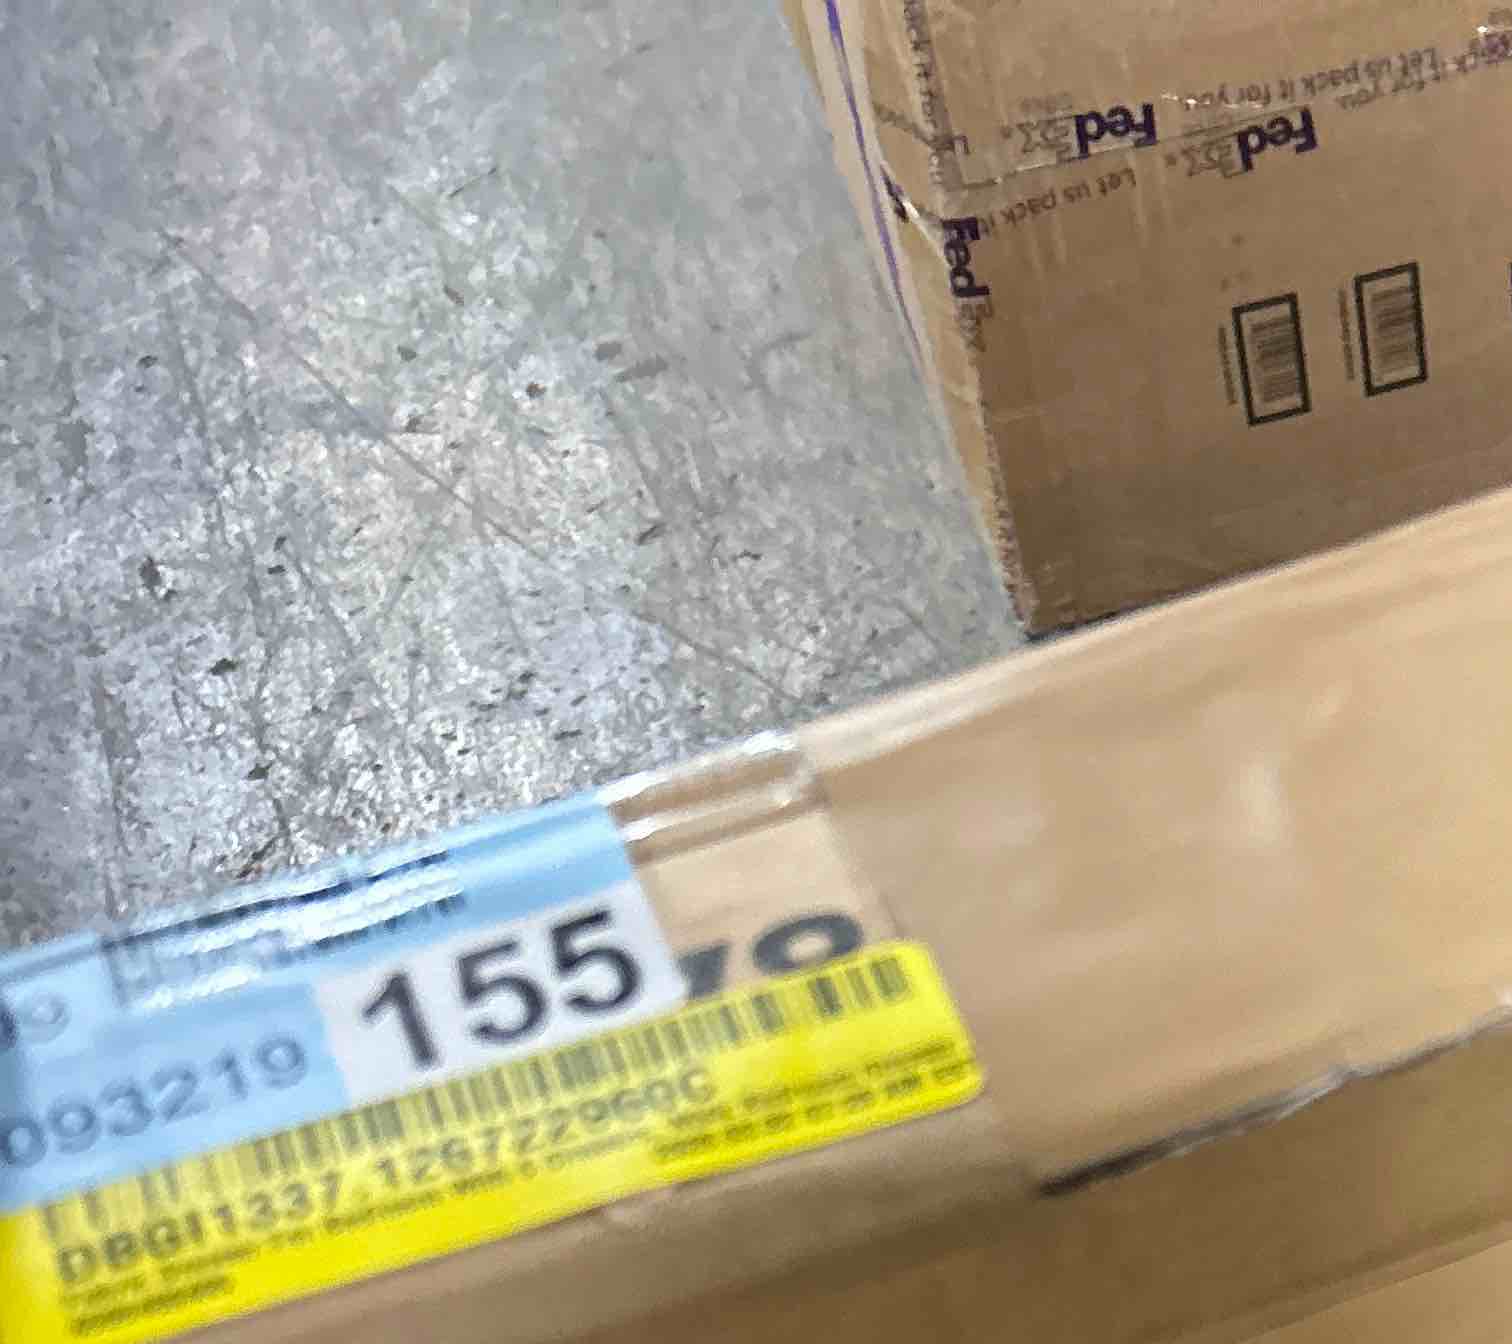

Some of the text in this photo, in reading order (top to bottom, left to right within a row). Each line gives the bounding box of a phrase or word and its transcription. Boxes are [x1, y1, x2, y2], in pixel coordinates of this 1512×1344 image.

[1302, 62, 1359, 97] pack
[1063, 183, 1092, 203] us
[1099, 168, 1137, 198] Let
[1004, 190, 1058, 228] pack
[361, 907, 645, 1072] 155
